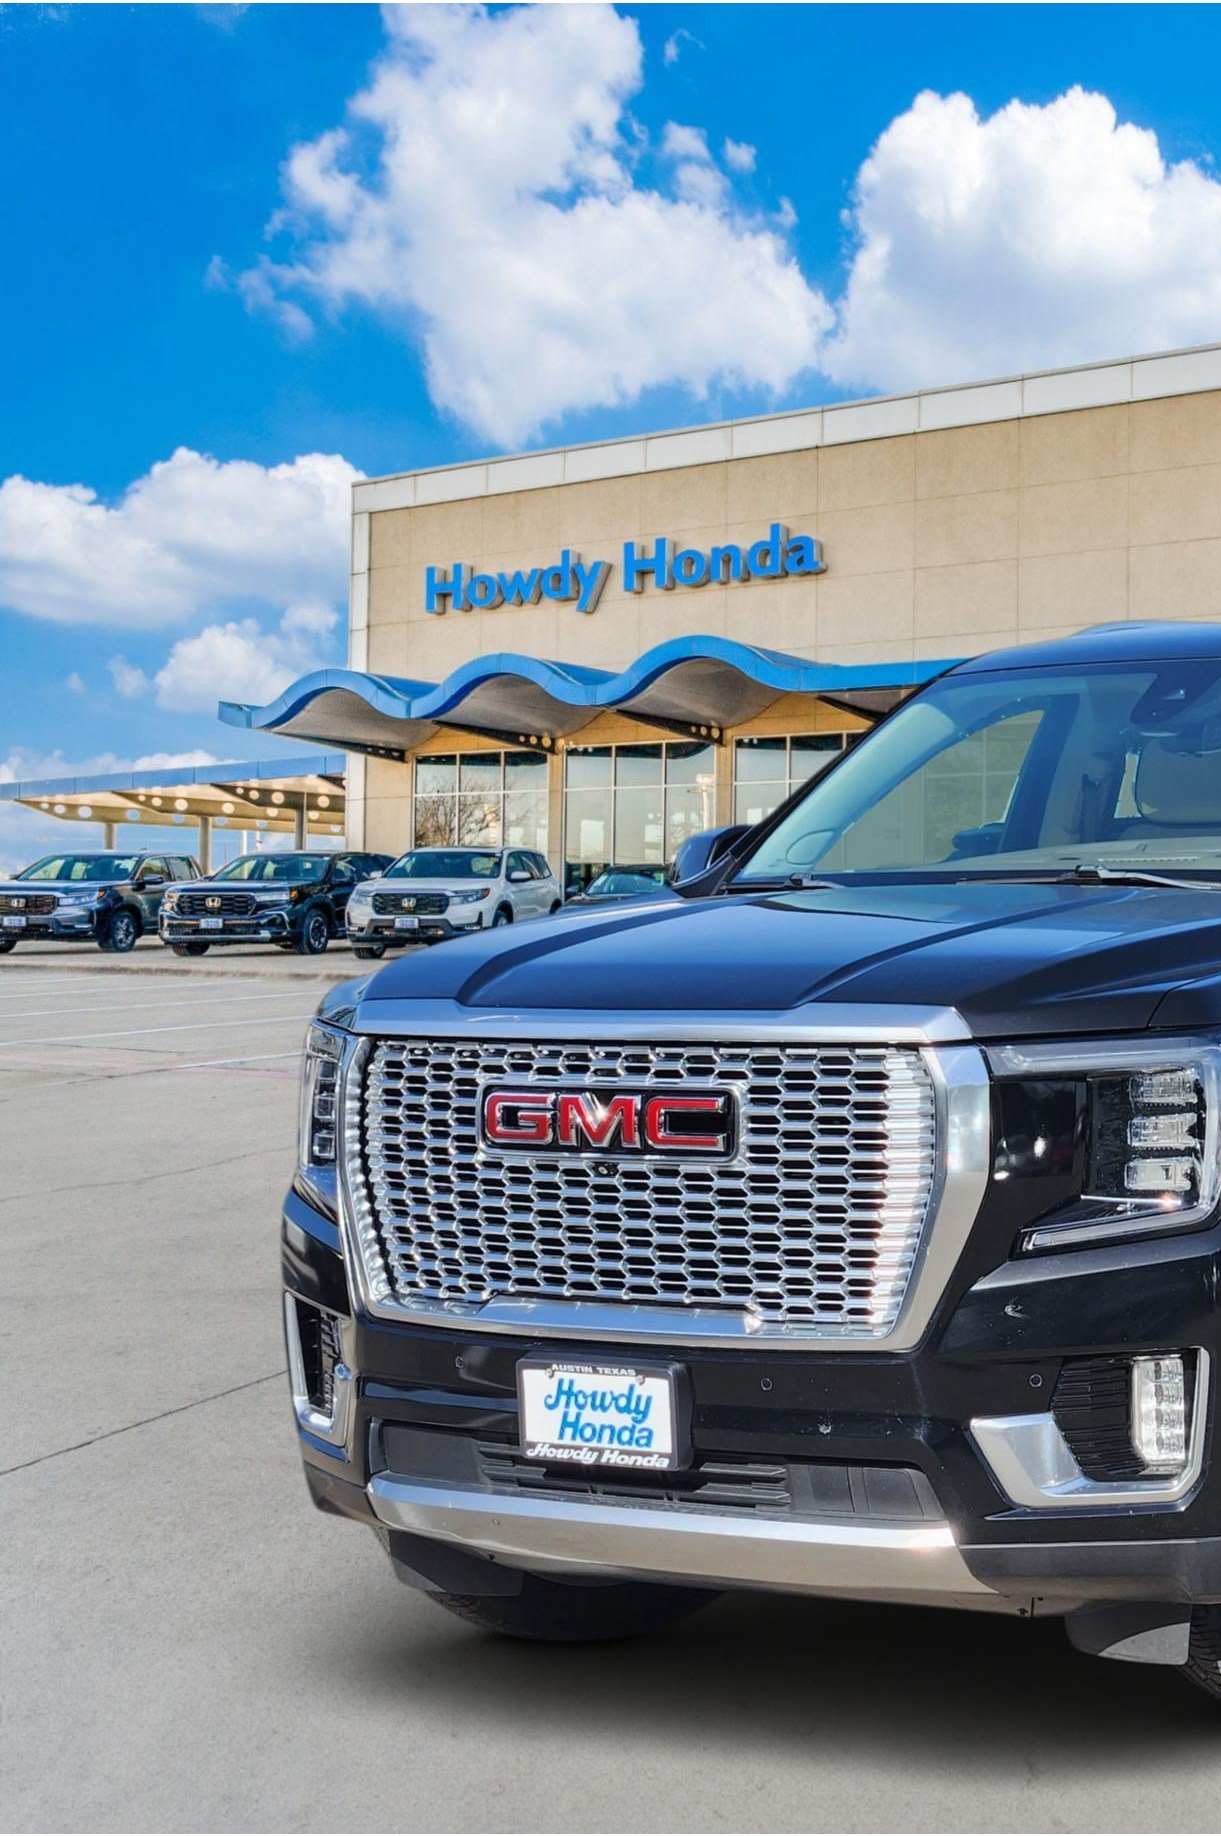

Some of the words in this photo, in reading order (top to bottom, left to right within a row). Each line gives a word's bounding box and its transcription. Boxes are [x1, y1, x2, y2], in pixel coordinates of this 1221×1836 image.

[425, 549, 613, 614] Howdy
[623, 522, 827, 593] Honda
[484, 1092, 728, 1150] GMC
[551, 1363, 594, 1374] AUSTIN
[597, 1366, 637, 1377] TEXAS
[544, 1378, 653, 1424] Howdy
[558, 1410, 654, 1448] Honda
[526, 1443, 600, 1465] Howdy
[601, 1449, 670, 1468] Honda
